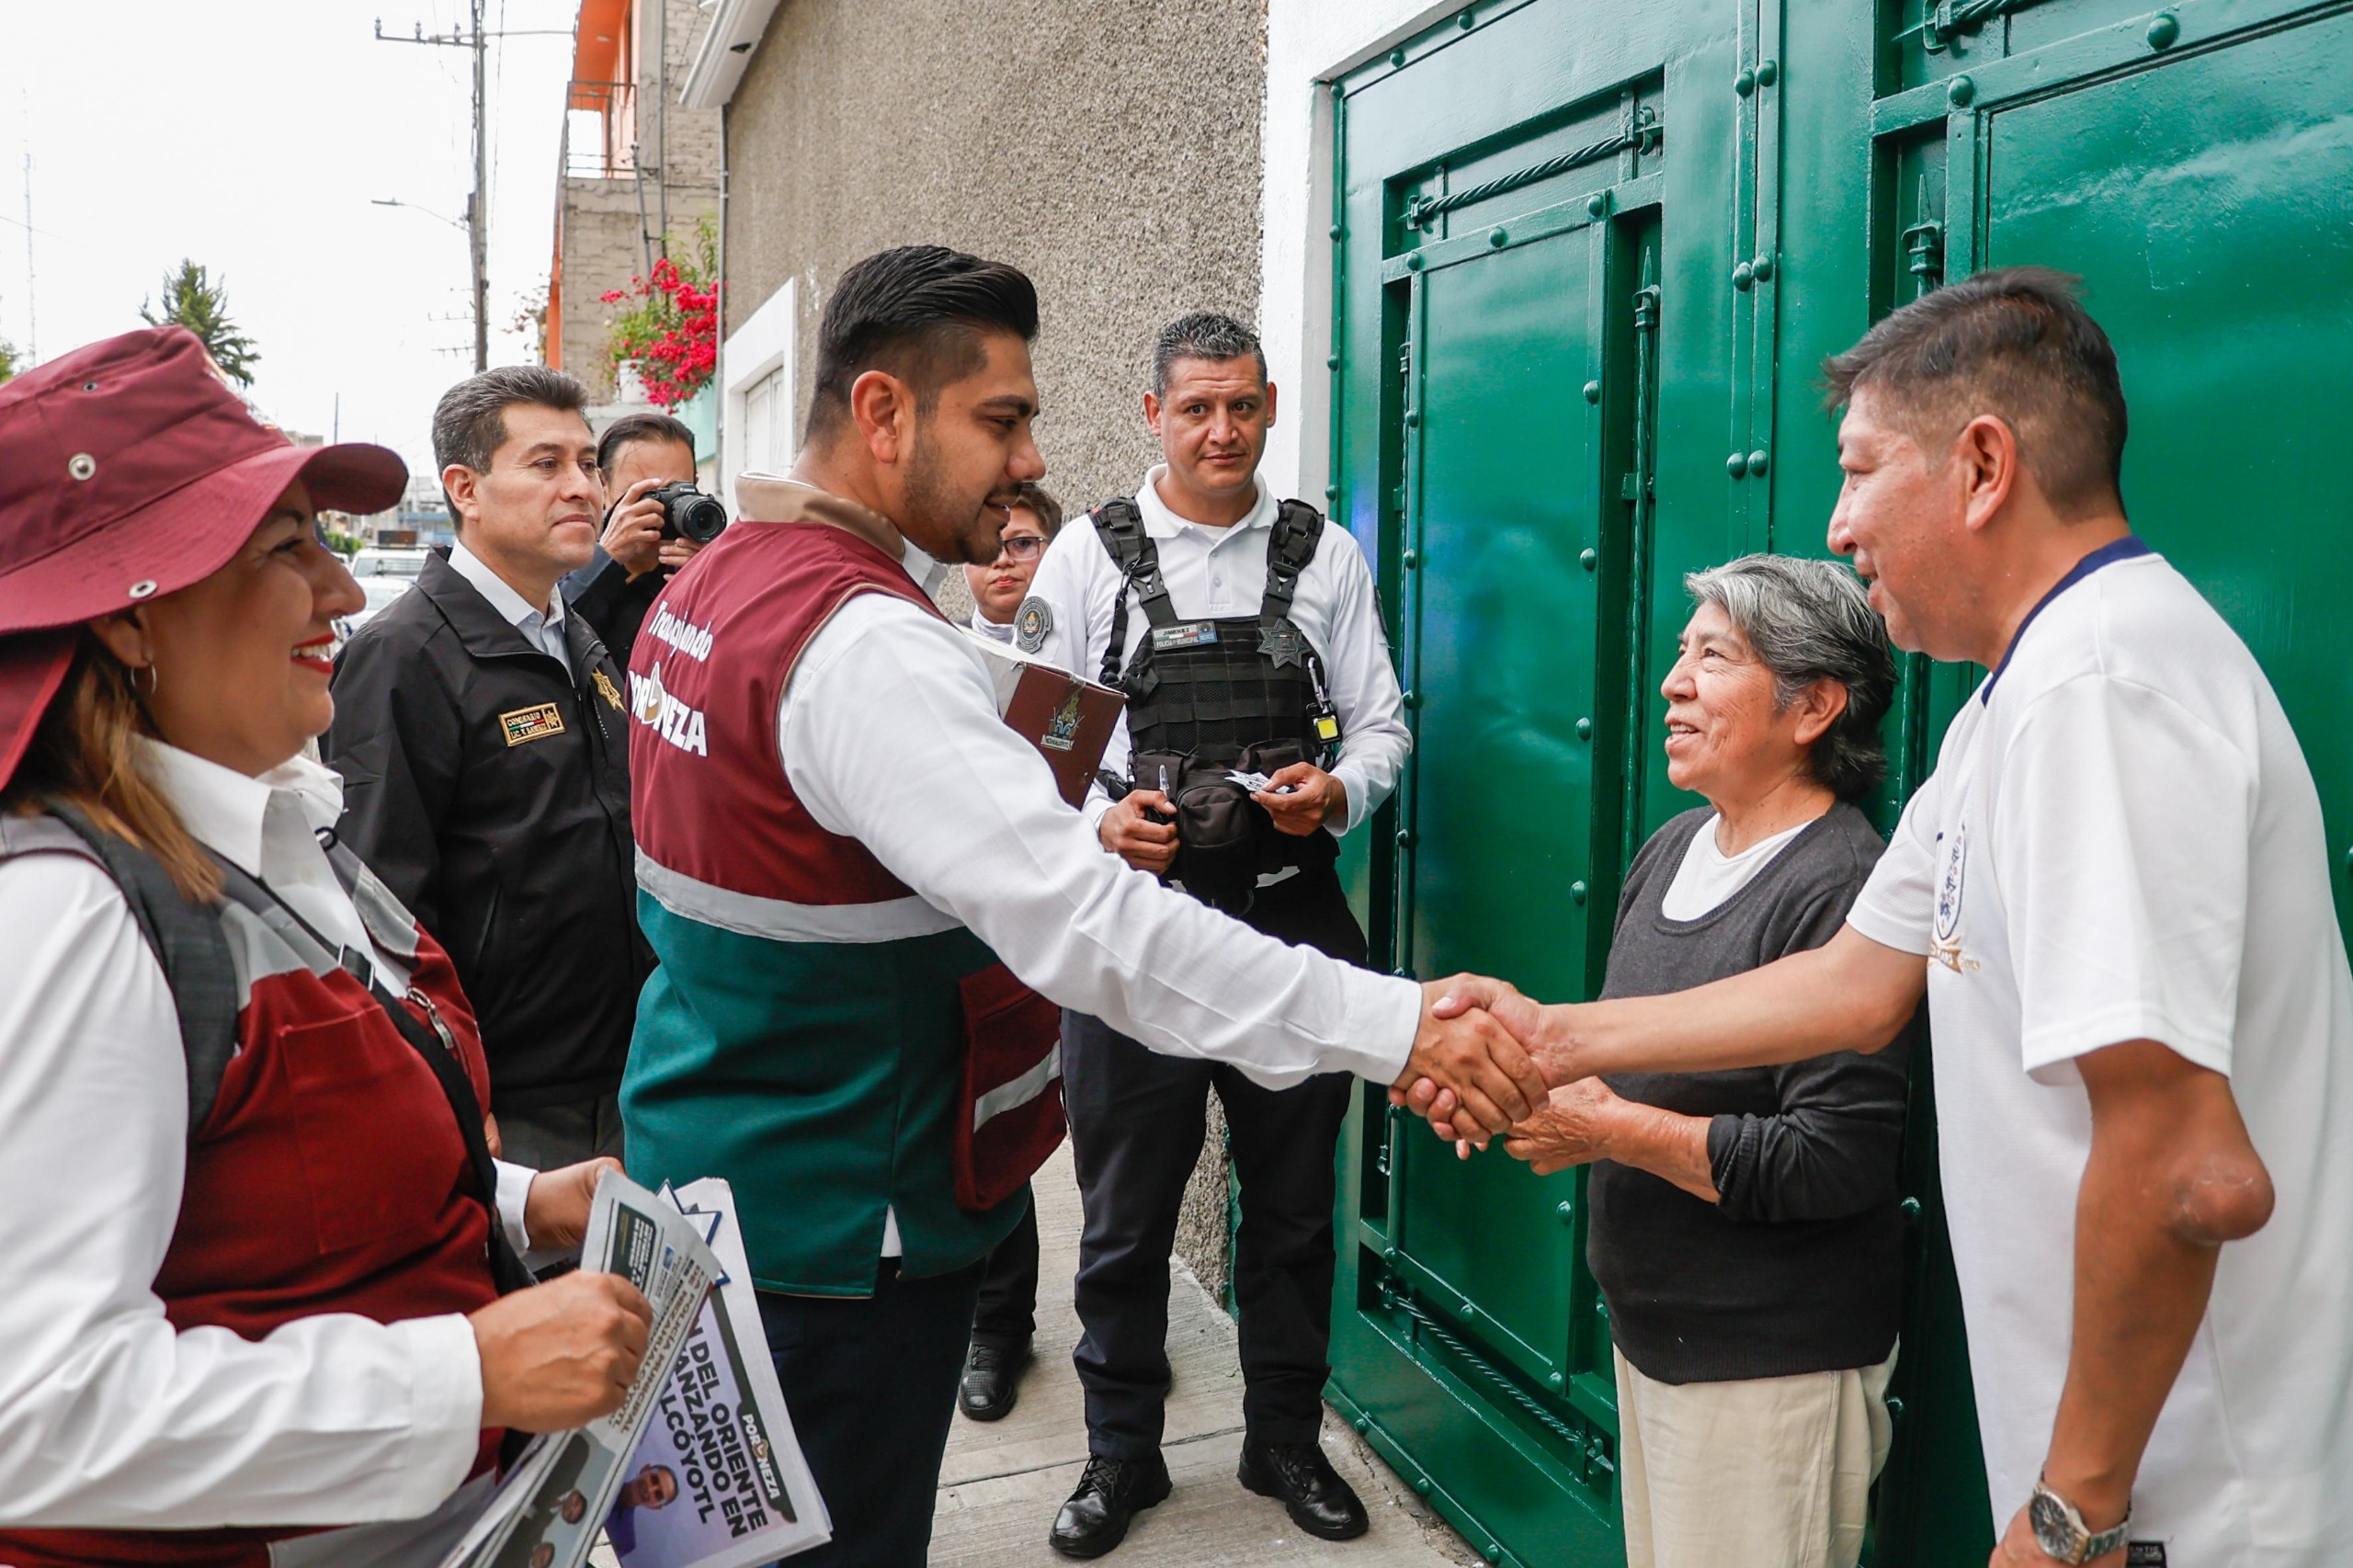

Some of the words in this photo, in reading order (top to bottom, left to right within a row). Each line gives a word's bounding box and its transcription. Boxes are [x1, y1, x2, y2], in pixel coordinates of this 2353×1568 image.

[647, 600, 713, 662] Trabajando
[620, 1356, 665, 1435] MUNICIPAL
[675, 1344, 732, 1493] ANZANDO
[721, 1495, 749, 1540] EN
[690, 1341, 721, 1401] DEL
[710, 1403, 768, 1531] ORIENTE
[658, 1381, 715, 1525] LCÓYOTL
[757, 1456, 780, 1500] NEZA
